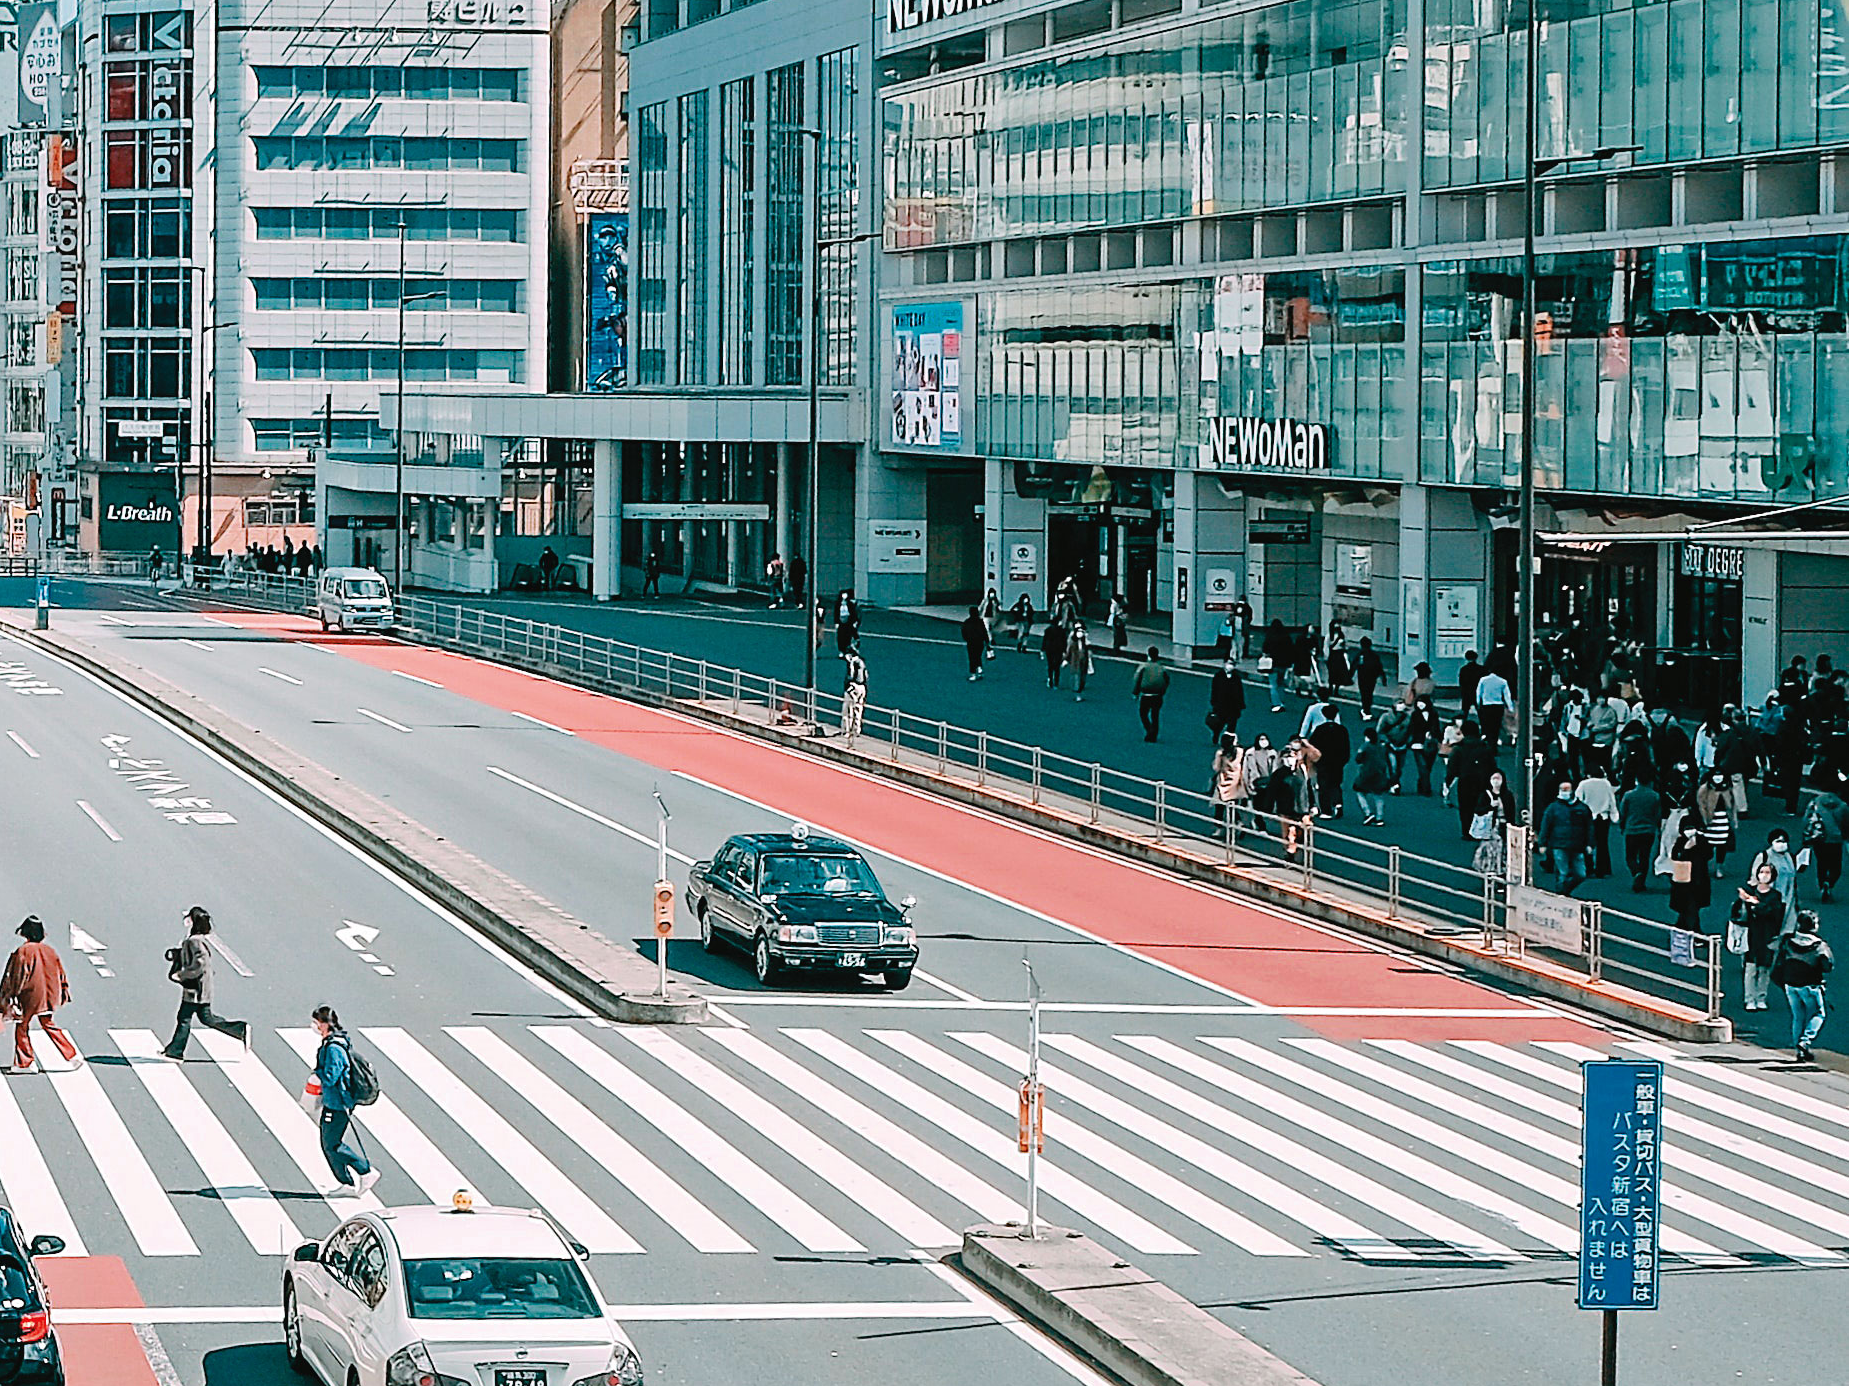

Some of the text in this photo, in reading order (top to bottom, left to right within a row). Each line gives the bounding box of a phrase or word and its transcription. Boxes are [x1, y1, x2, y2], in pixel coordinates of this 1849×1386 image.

[152, 14, 183, 183] Victoria
[1587, 1197, 1608, 1301] 入れません
[1611, 1112, 1633, 1259] バスタ新宿へは
